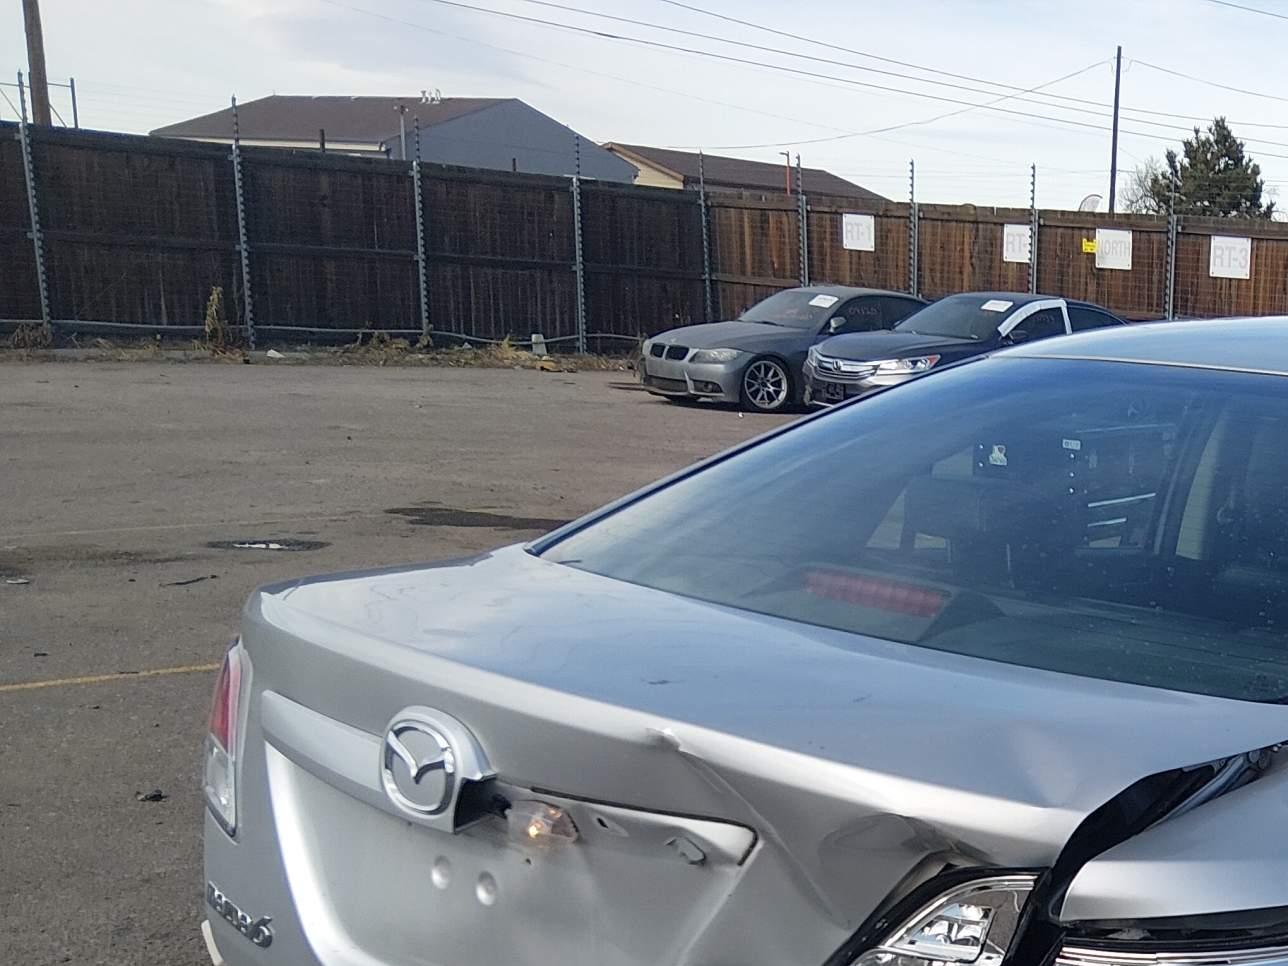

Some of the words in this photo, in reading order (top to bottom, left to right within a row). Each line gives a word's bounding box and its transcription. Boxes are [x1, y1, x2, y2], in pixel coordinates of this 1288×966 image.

[845, 222, 872, 241] RT-1
[1006, 233, 1029, 253] RT-
[1099, 239, 1131, 257] NORTH
[1213, 245, 1249, 269] RT-3
